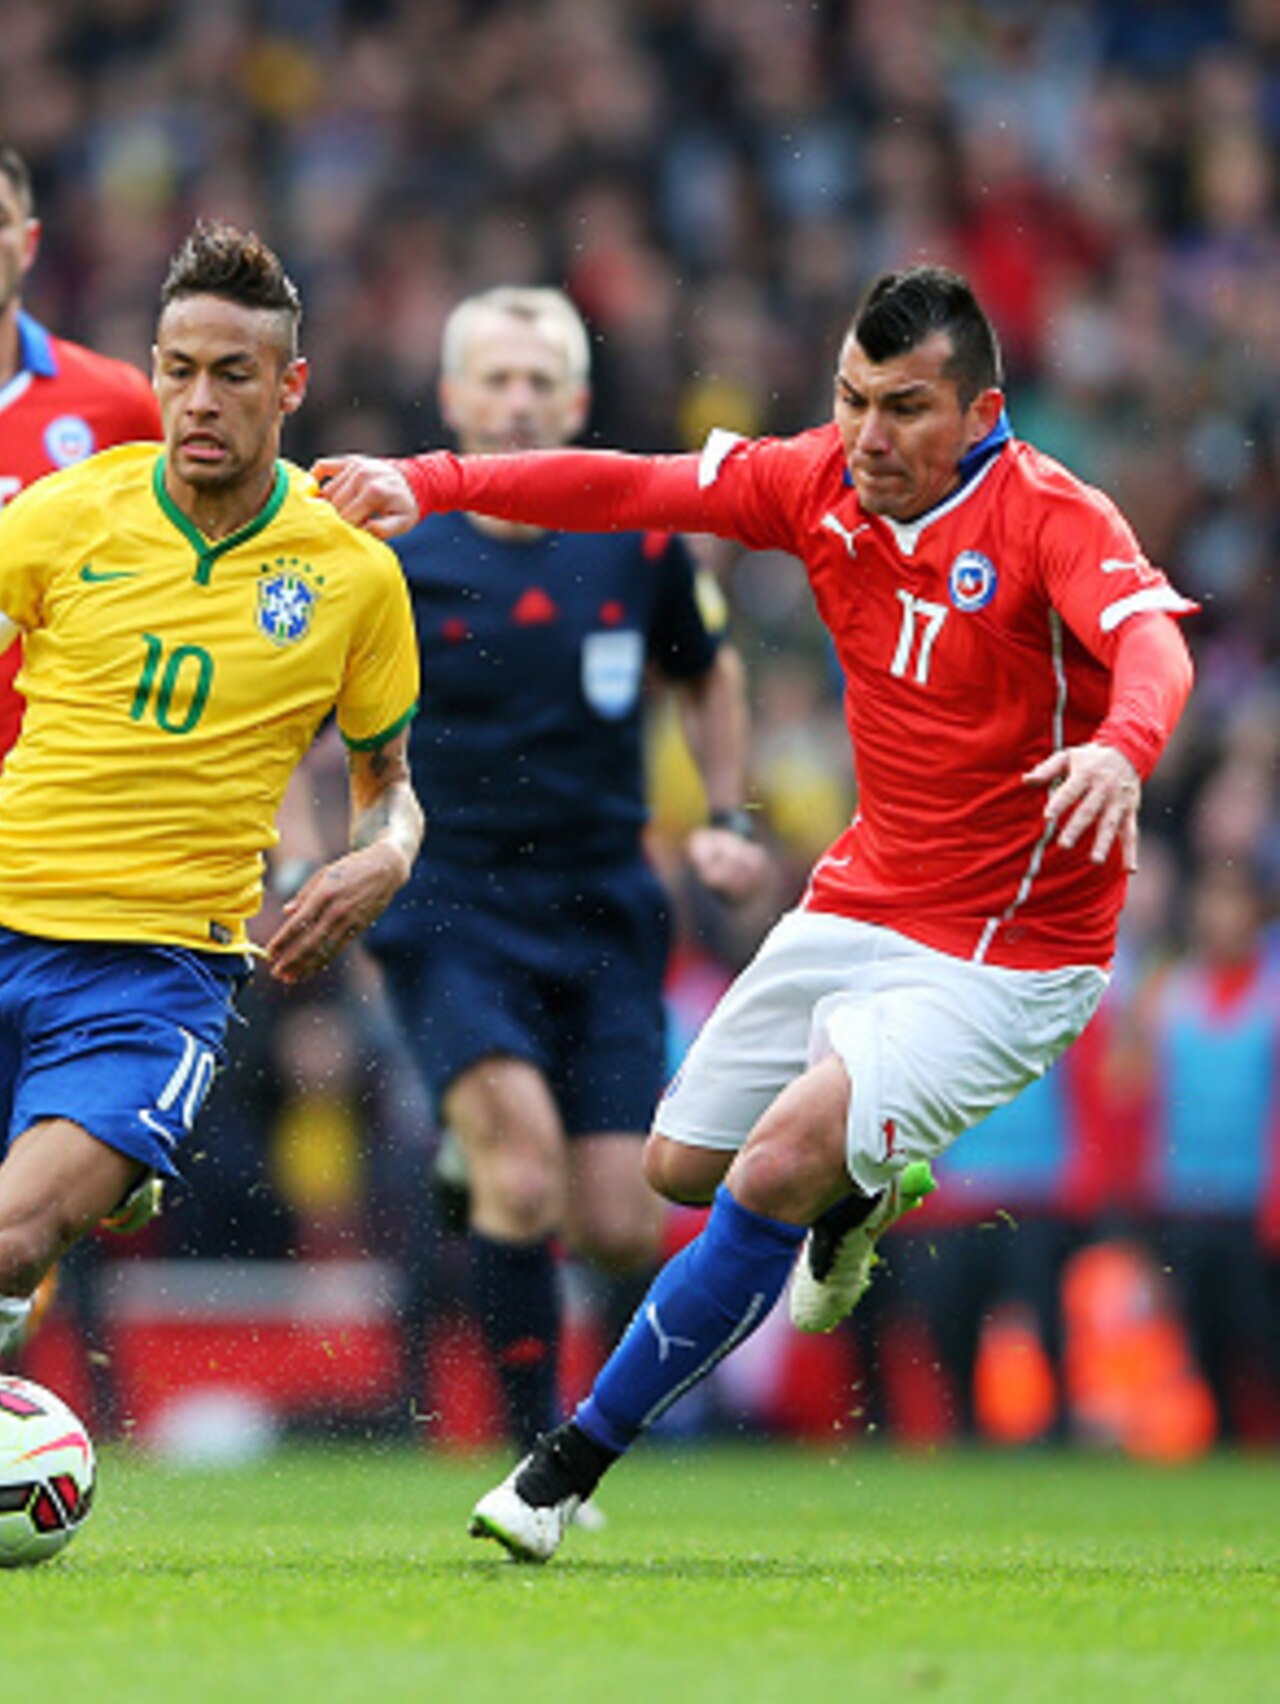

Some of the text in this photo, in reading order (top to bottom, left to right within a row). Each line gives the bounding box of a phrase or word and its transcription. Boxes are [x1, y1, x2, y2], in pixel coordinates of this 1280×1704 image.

[130, 632, 214, 734] 10
[890, 588, 949, 685] 17
[156, 1026, 215, 1130] 10
